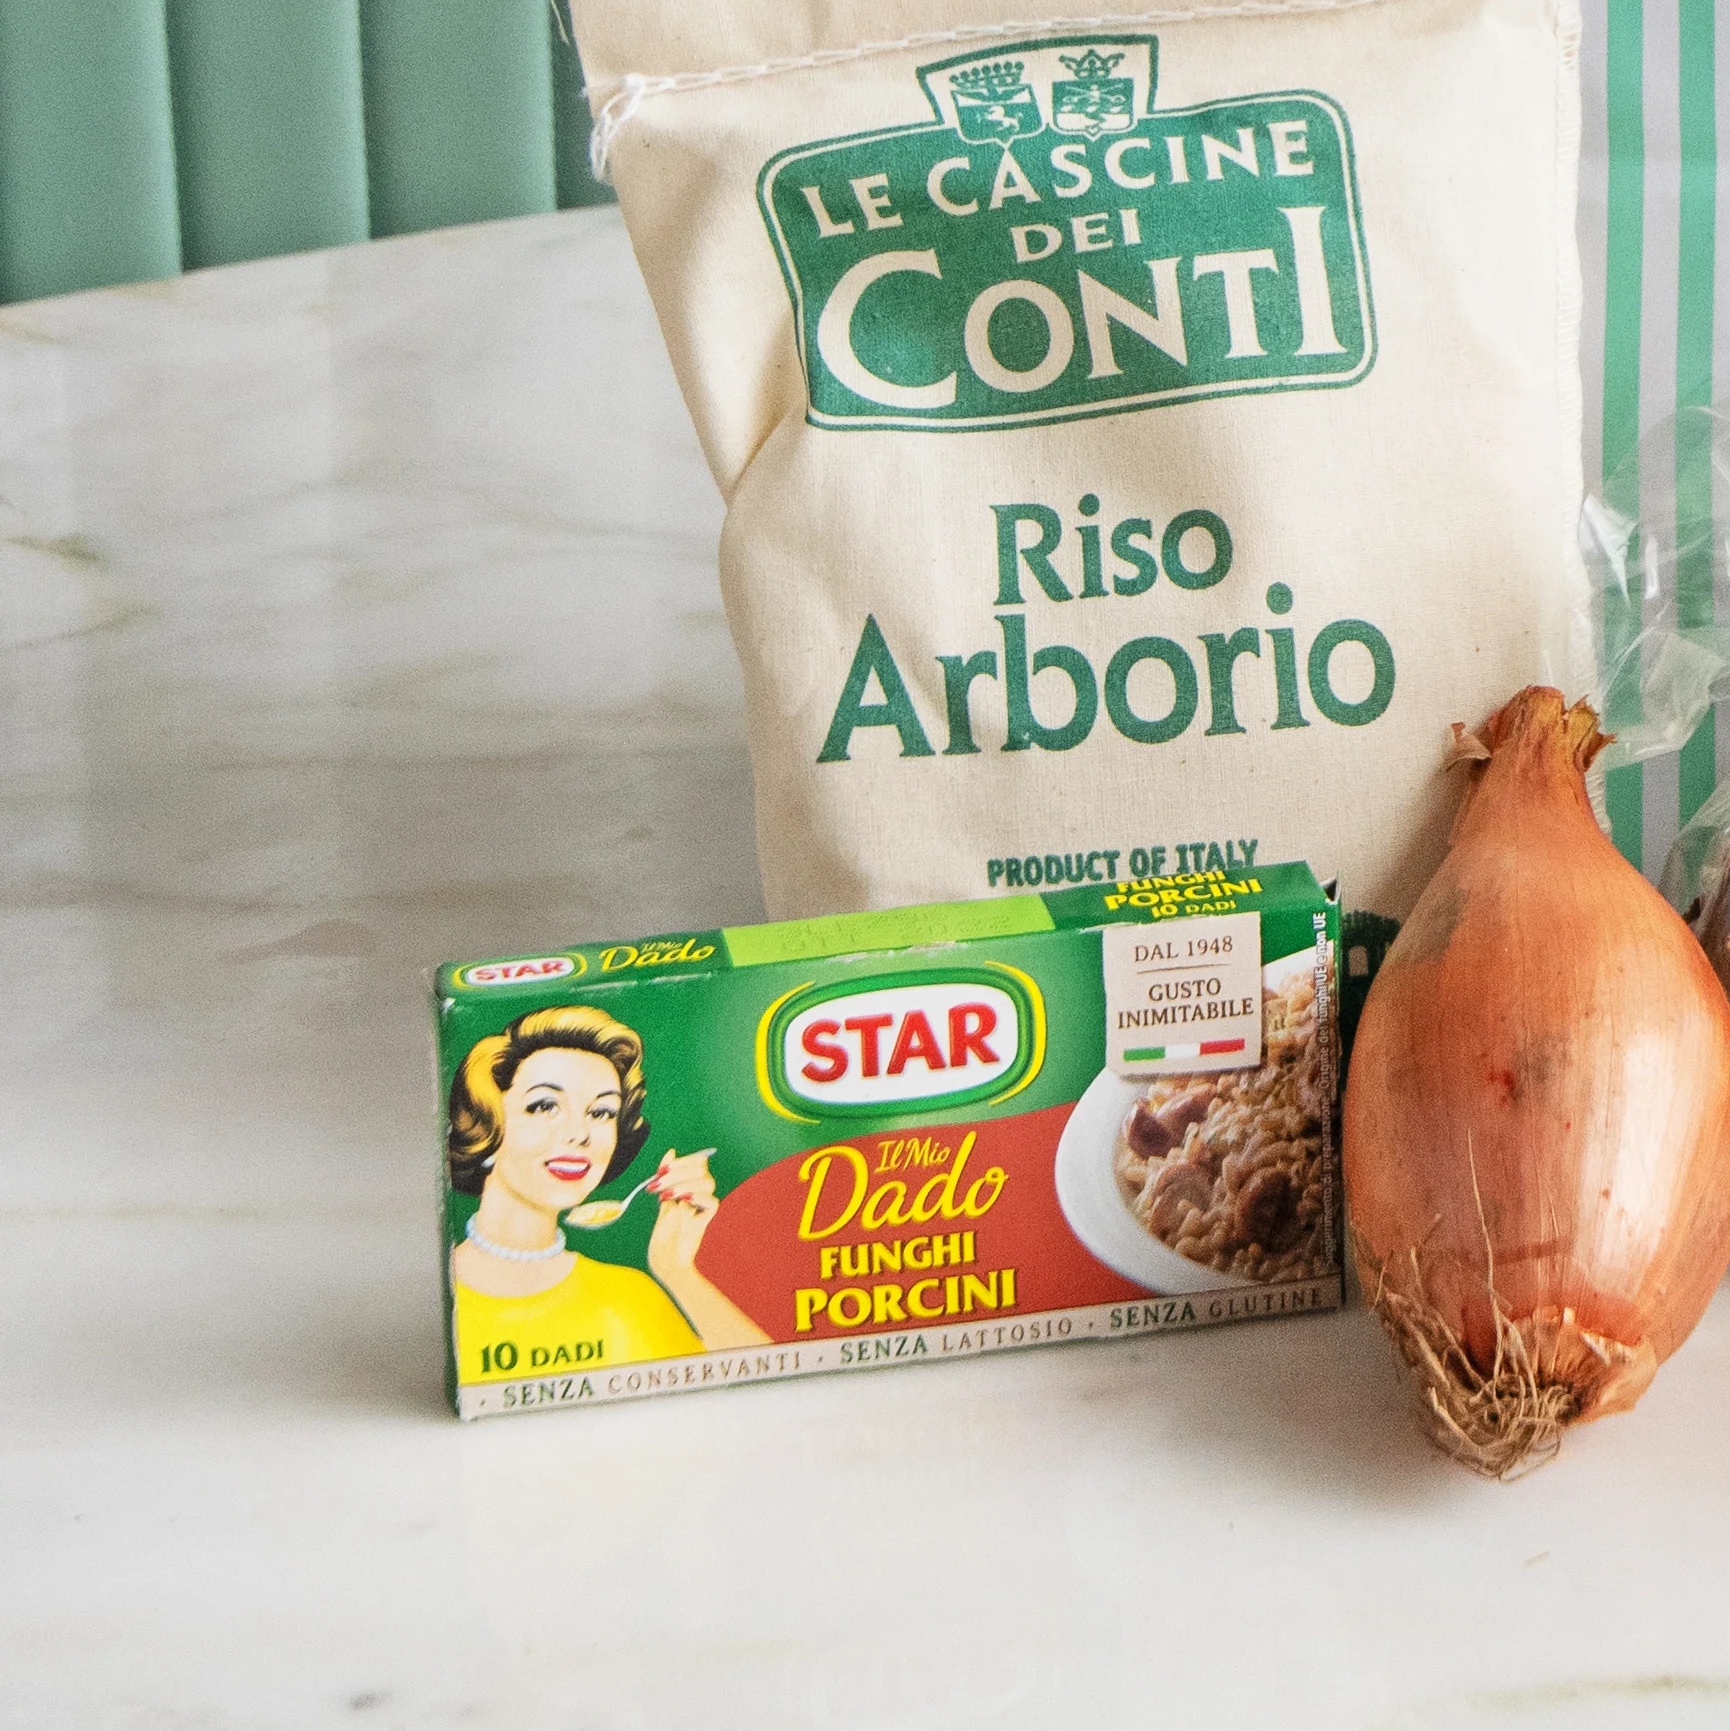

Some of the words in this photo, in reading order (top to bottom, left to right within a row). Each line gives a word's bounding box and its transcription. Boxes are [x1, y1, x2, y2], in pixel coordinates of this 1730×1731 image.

[800, 172, 904, 239] LE
[926, 119, 1315, 219] CASCINE
[1009, 208, 1143, 264] DEI
[815, 205, 1348, 410] CONTI
[989, 493, 1234, 606] Riso
[815, 582, 1397, 764] Arborio
[986, 849, 1121, 888] PRODUCT
[1128, 845, 1167, 878] OF
[1174, 837, 1259, 875] ITALY
[1116, 869, 1227, 894] FUNGHI
[1103, 878, 1263, 911] PORCINI
[1151, 903, 1179, 918] 10
[1184, 899, 1237, 915] DADI
[1312, 912, 1326, 929] UE
[598, 938, 716, 973] Dado
[1134, 942, 1179, 963] DAL
[1187, 935, 1234, 957] 1948
[1315, 931, 1327, 956] non
[474, 960, 565, 981] STAR
[1148, 977, 1222, 1002] GUSTO
[1117, 996, 1254, 1030] INIMITABILE
[799, 1002, 1001, 1085] STAR
[873, 1139, 906, 1174] Il
[902, 1136, 951, 1171] Mio
[797, 1130, 1010, 1242] Dado
[819, 1230, 978, 1281] FUNGHI
[794, 1267, 1018, 1334] PORCINI
[480, 1341, 520, 1374] 10
[529, 1338, 606, 1369] DADI
[502, 1375, 596, 1409] SENZA
[606, 1350, 801, 1395] CONSERVANTI
[839, 1334, 930, 1365] SENZA
[940, 1317, 1074, 1353] LATTOSIO
[1109, 1299, 1197, 1330] SENZA
[1207, 1287, 1326, 1319] GLUTINE
